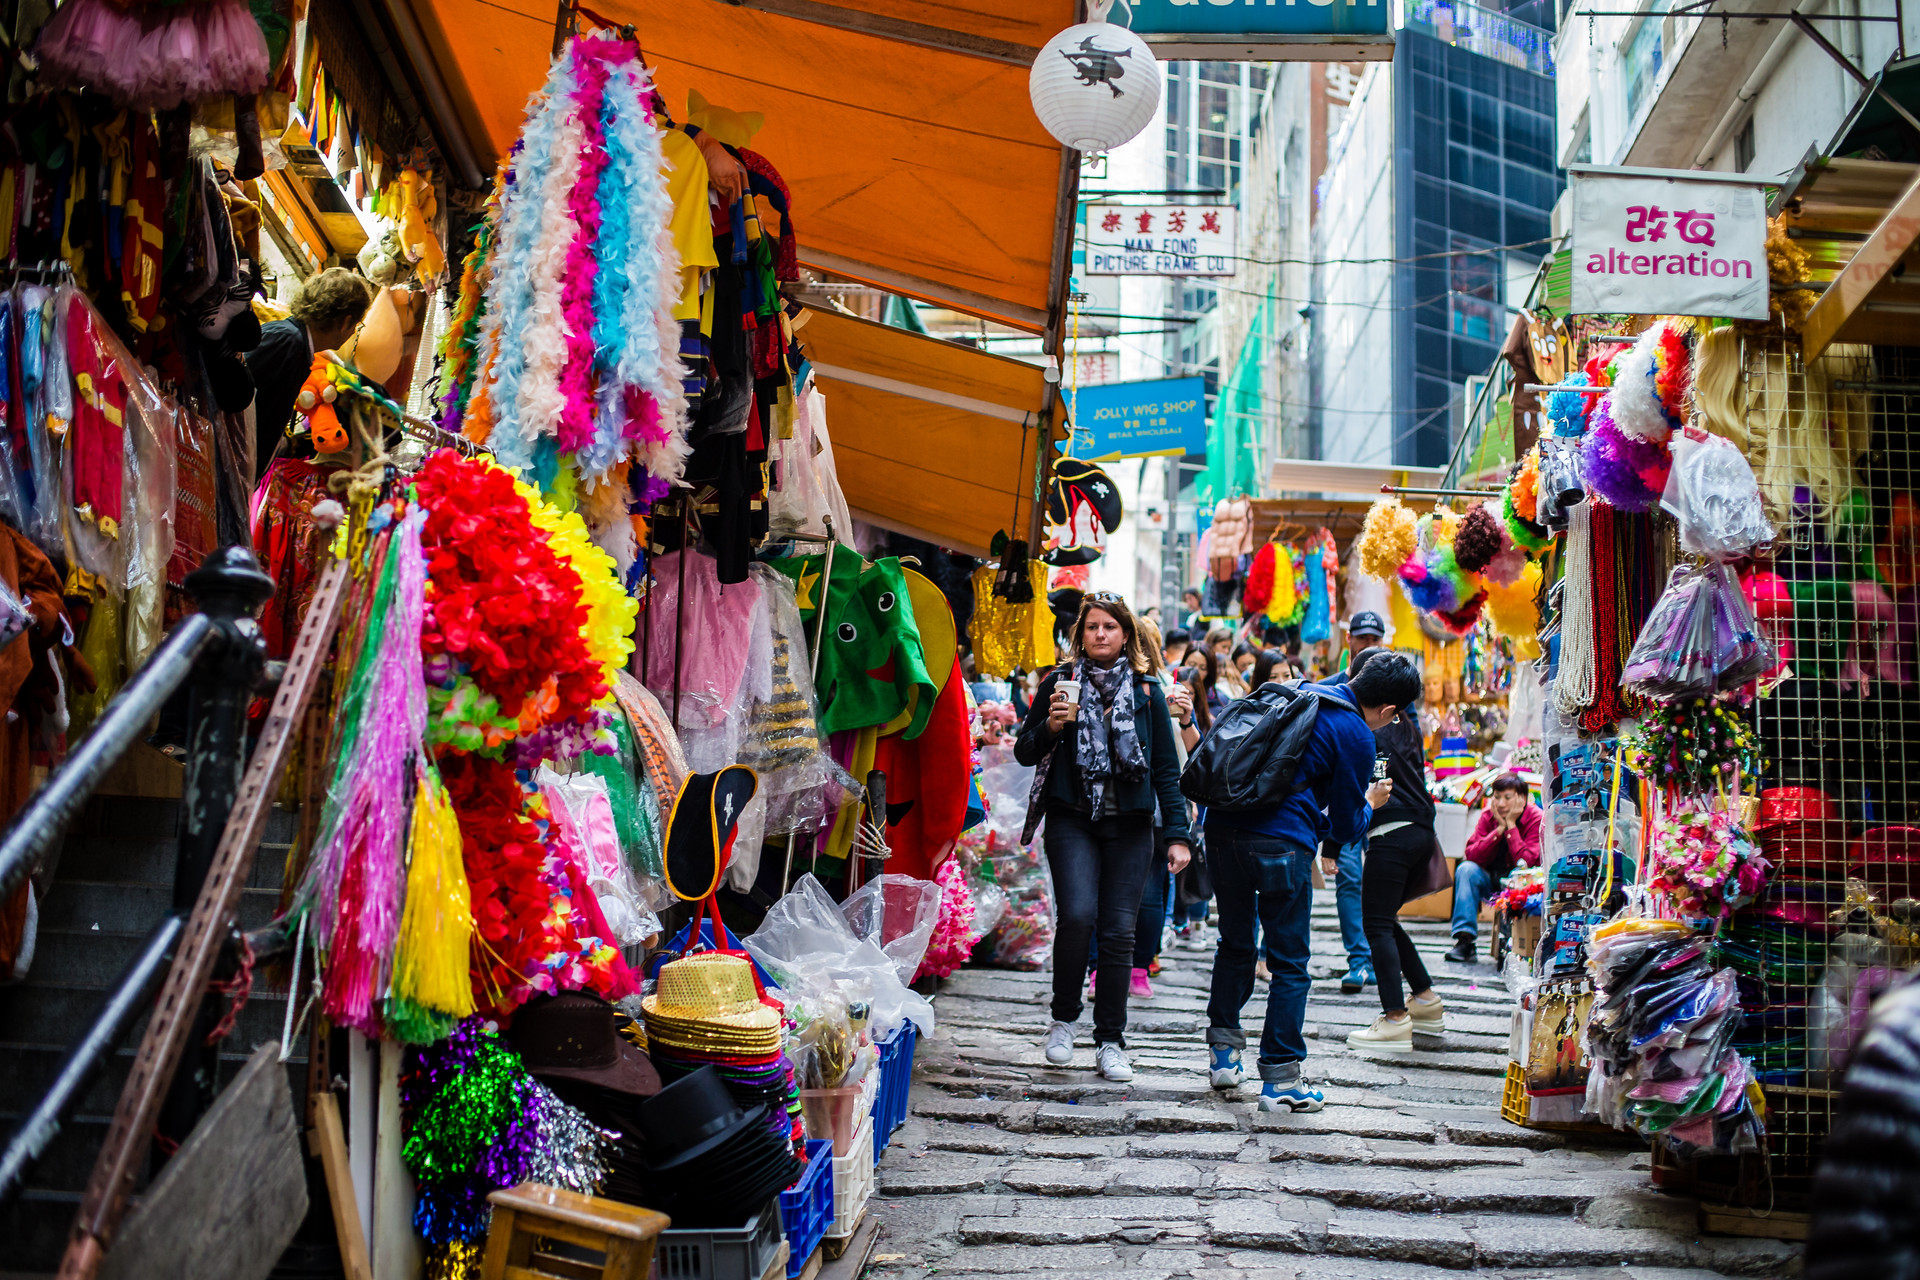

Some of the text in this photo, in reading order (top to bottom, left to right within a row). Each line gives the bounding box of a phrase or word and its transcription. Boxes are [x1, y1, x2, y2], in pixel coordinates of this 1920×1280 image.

[1125, 238, 1197, 254] MAN FONG
[1094, 255, 1149, 271] PICTURE
[1156, 256, 1199, 271] FRAME
[1586, 247, 1753, 279] alteration
[1093, 400, 1197, 421] JOLLY WIG SHOP
[1108, 426, 1182, 440] RETAIL WHOLESALE
